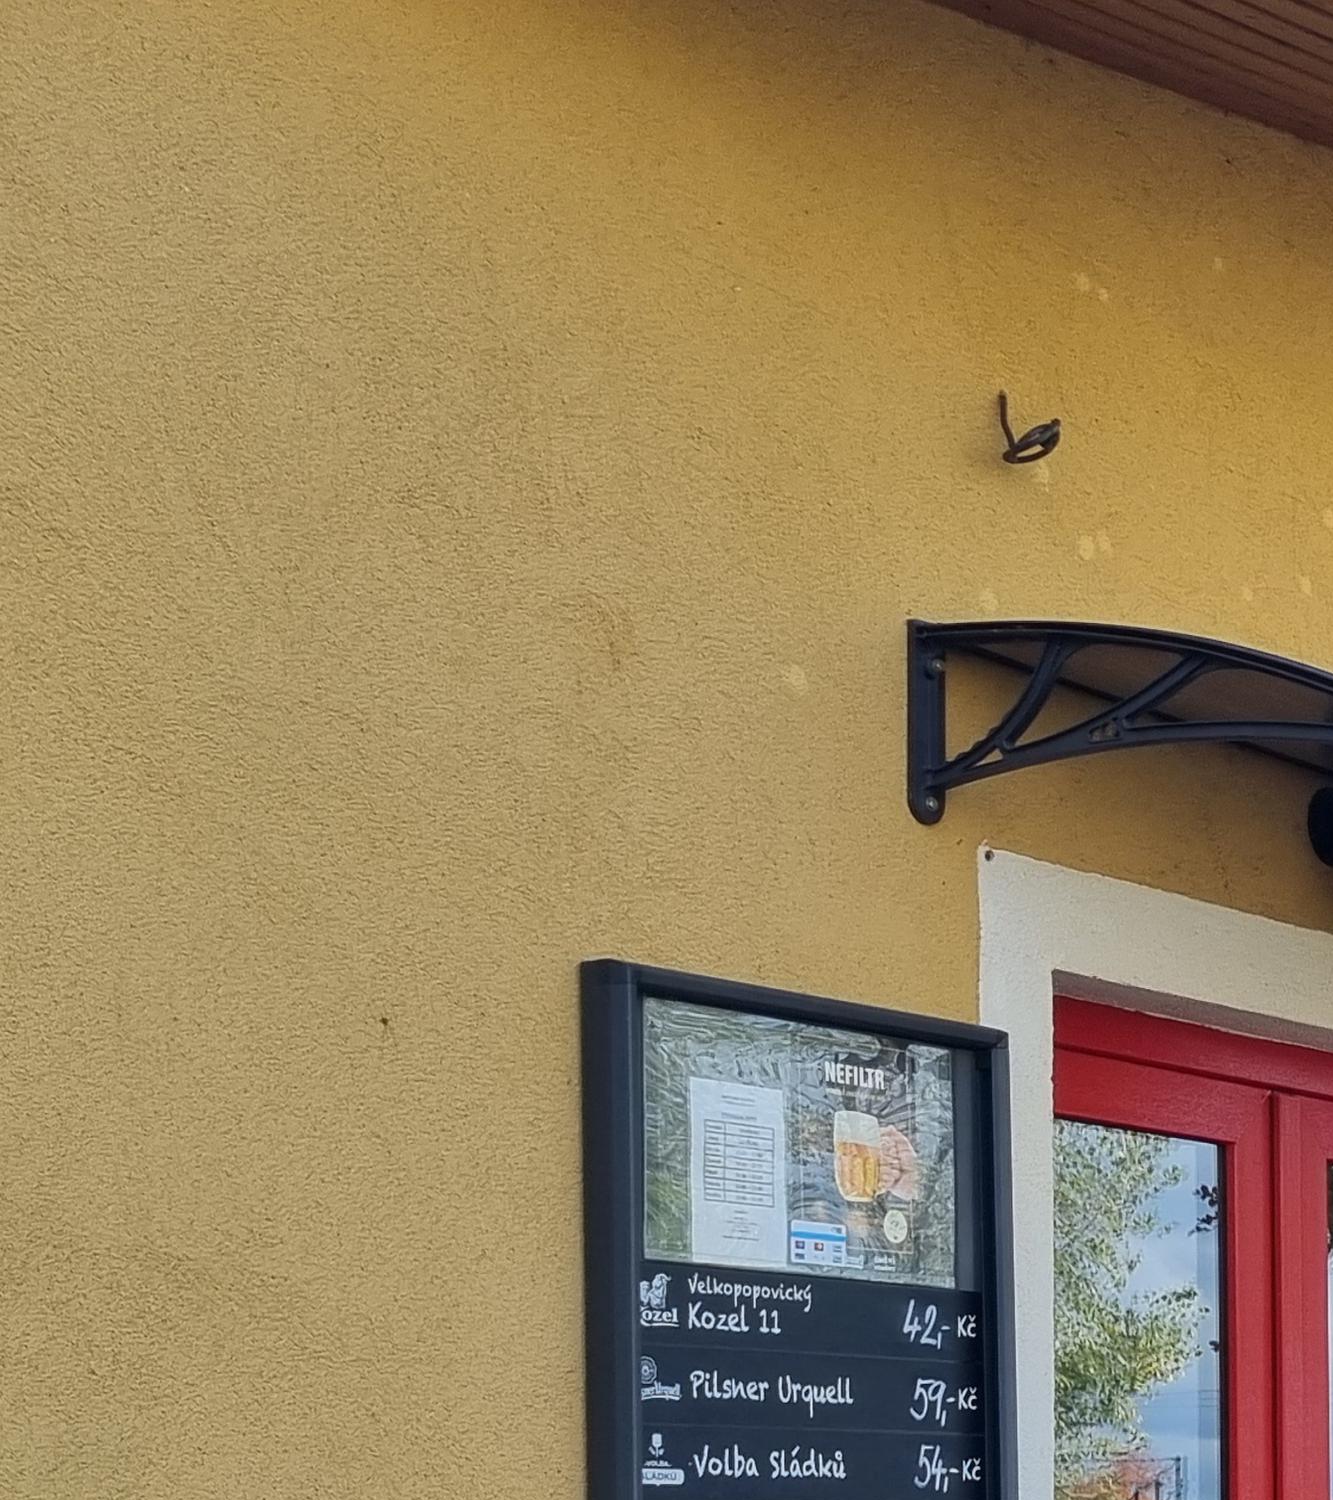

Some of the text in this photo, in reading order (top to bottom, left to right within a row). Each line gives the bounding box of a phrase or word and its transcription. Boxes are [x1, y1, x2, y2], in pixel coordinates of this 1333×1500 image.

[824, 1061, 886, 1090] NEFILTR
[688, 1272, 812, 1312] Velkopopovický
[688, 1301, 781, 1334] Kozel 11
[903, 1299, 977, 1350] 42,- Kč
[689, 1370, 769, 1402] Pilsner
[778, 1375, 854, 1418] Urquell
[909, 1378, 956, 1427] 59,-
[693, 1444, 759, 1478] Volba
